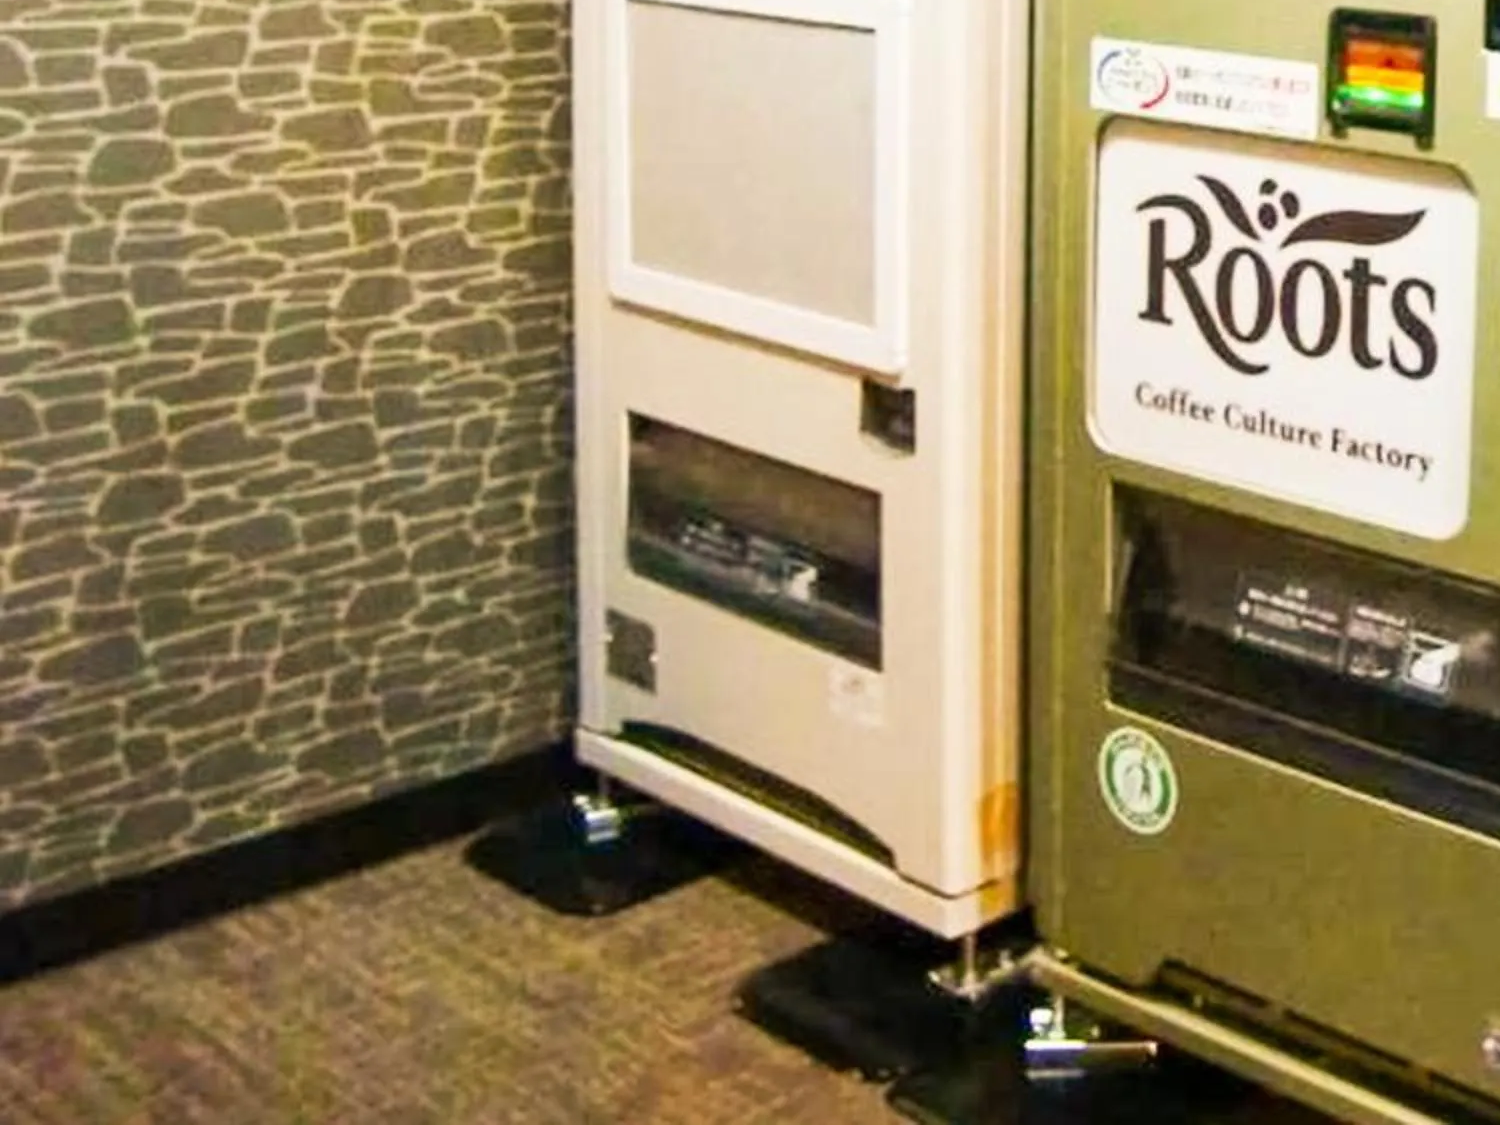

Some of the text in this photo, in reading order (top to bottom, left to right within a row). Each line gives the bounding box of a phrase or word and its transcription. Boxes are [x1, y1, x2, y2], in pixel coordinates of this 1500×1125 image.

[1136, 193, 1439, 381] Roots
[1134, 381, 1434, 481] Coffee Culture Factory
